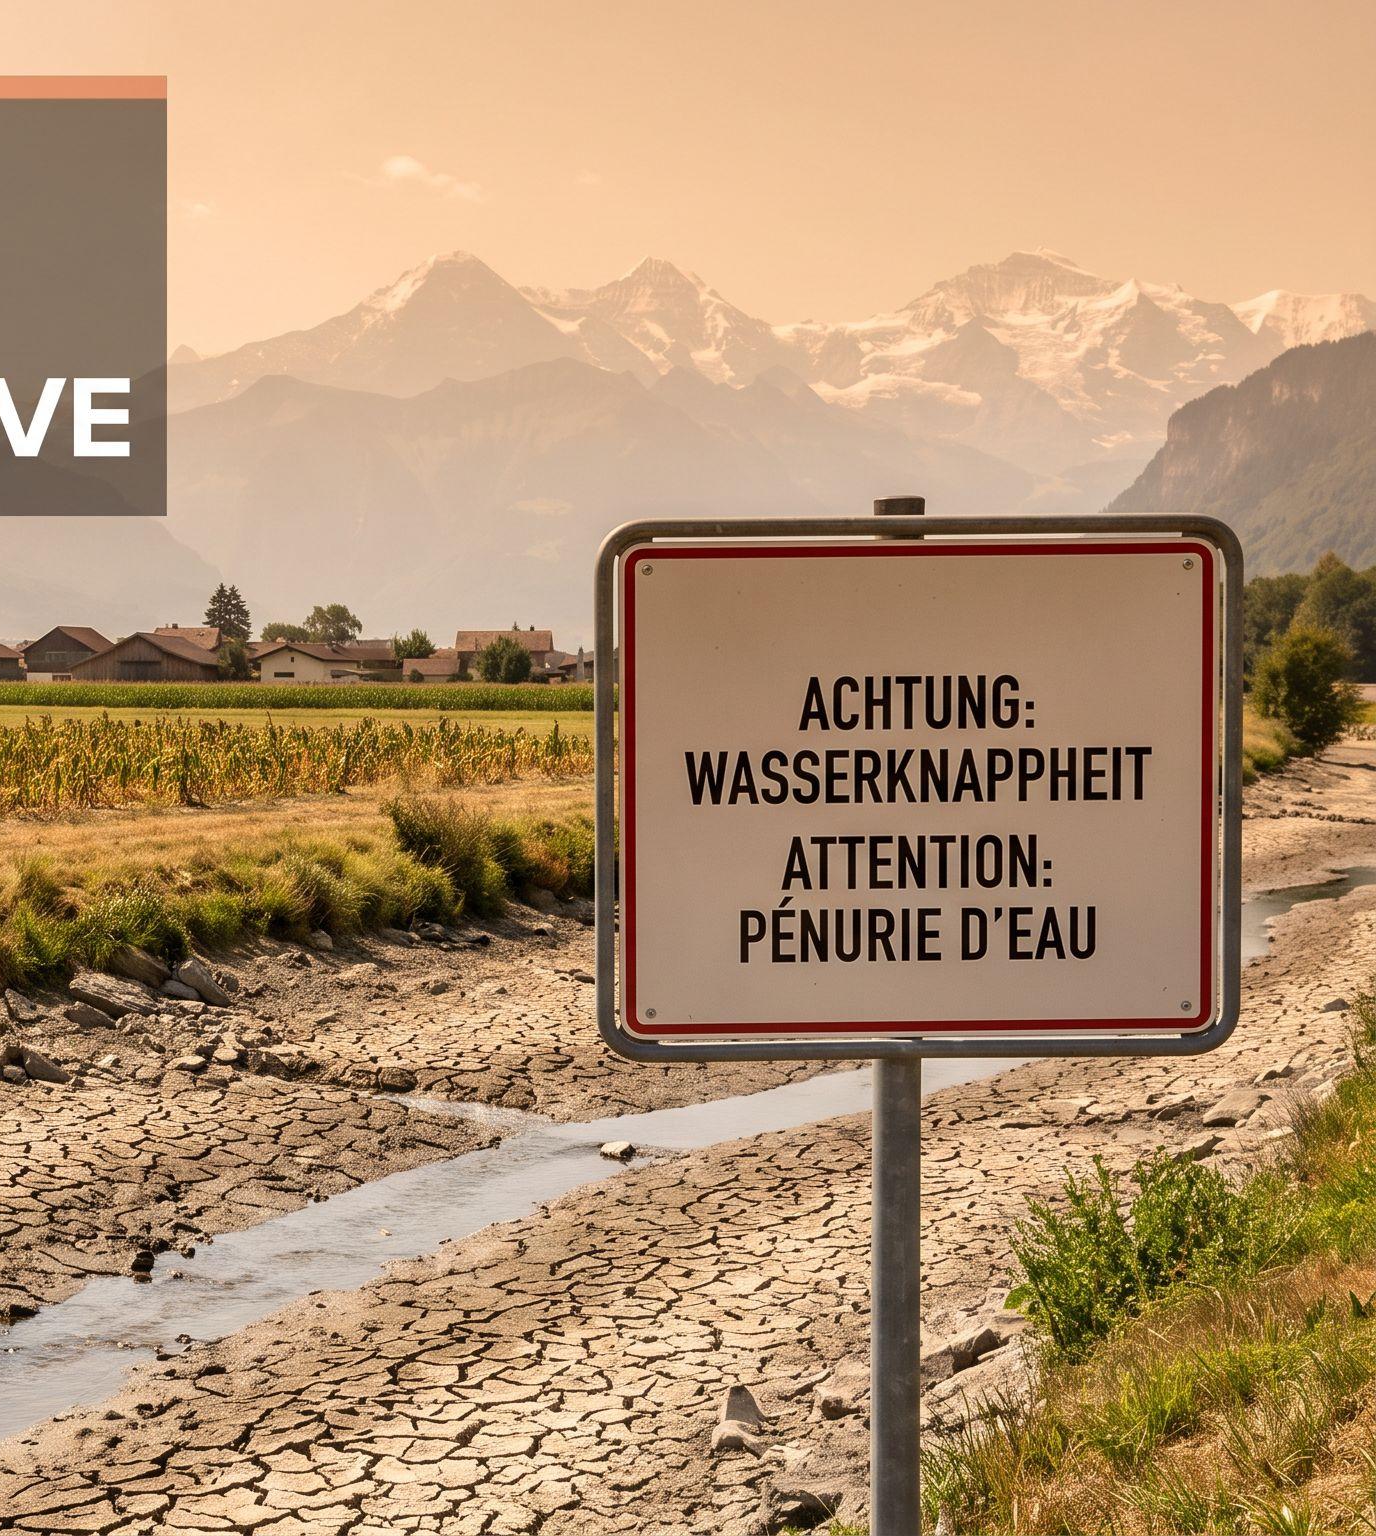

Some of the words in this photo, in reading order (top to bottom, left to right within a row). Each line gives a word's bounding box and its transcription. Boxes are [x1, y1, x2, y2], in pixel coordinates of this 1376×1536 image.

[798, 674, 1035, 731] ACHTUNG:
[684, 746, 1153, 806] WASSERKNAPPHEIT
[781, 834, 1053, 891] ATTENTION:
[739, 896, 942, 964] PÉNURIE
